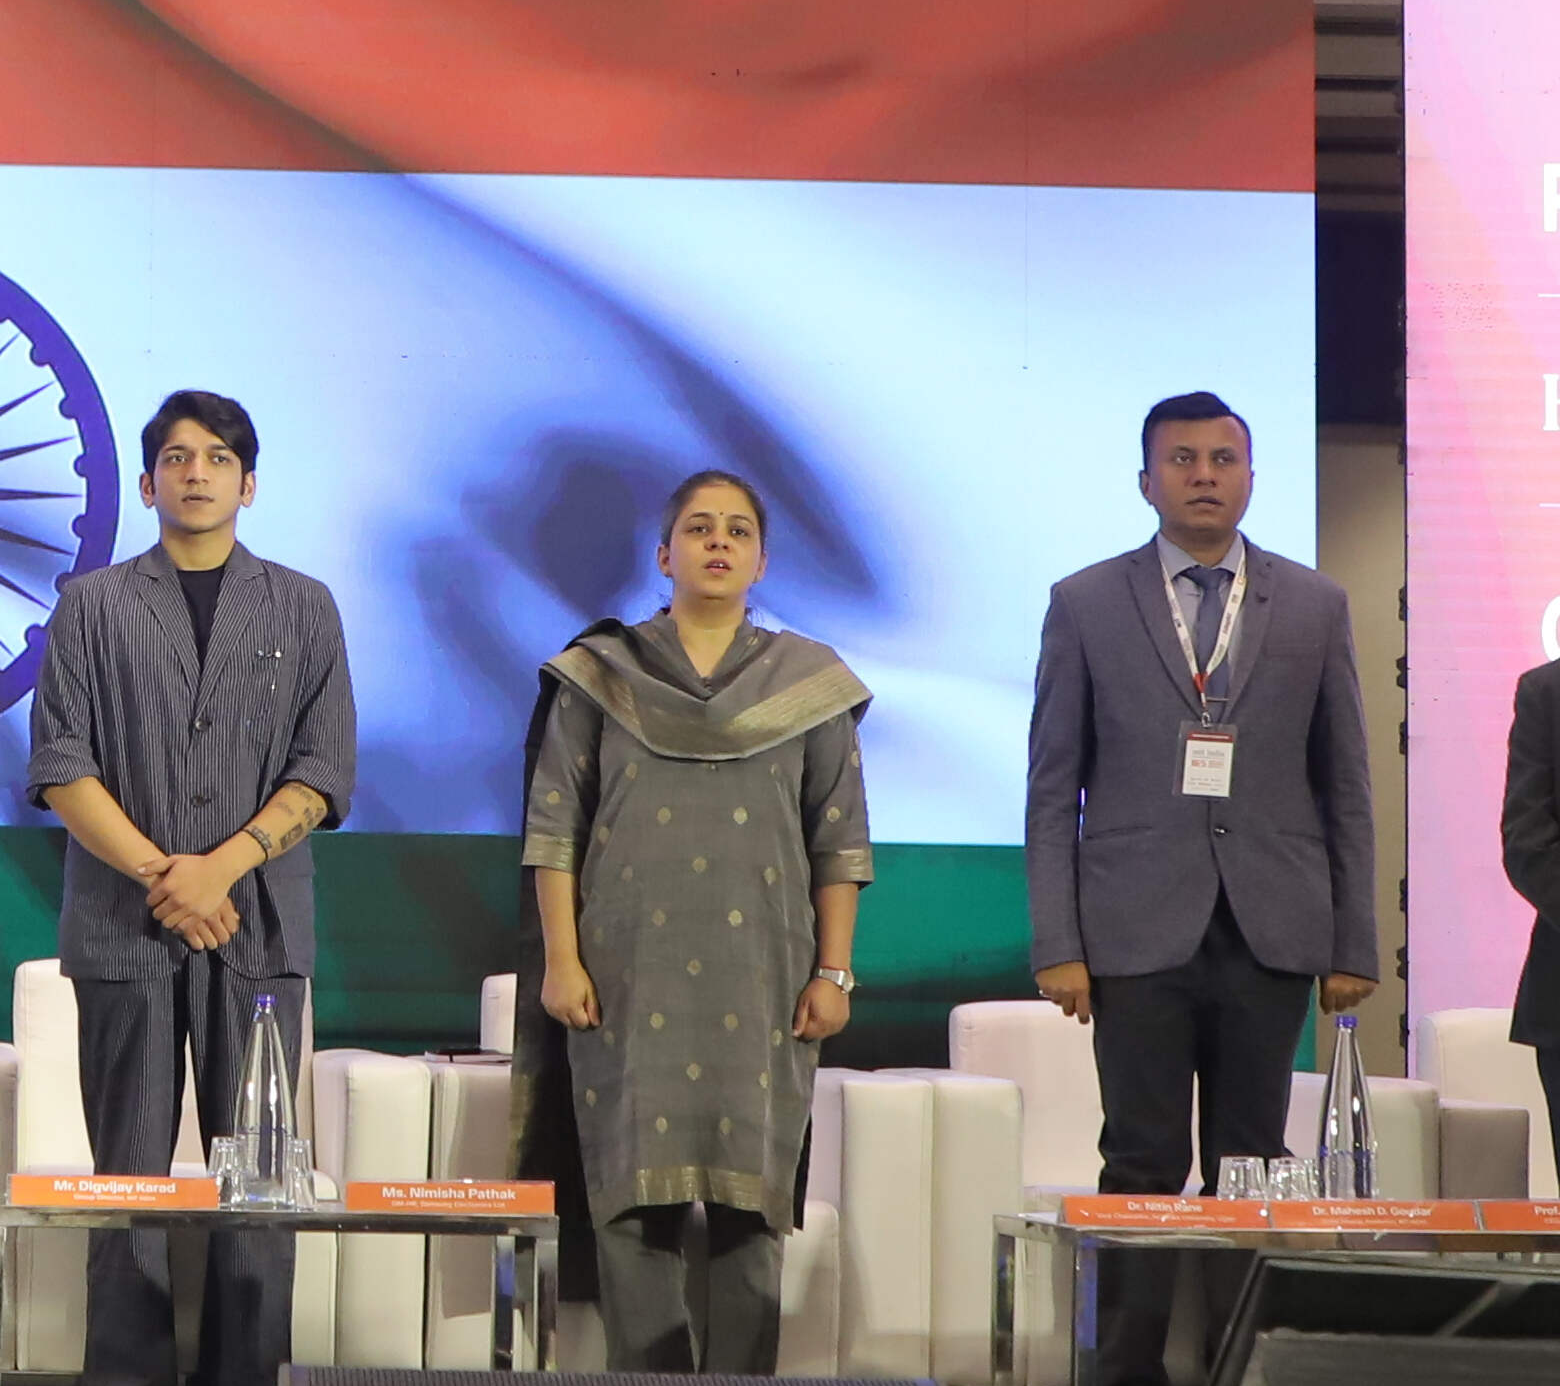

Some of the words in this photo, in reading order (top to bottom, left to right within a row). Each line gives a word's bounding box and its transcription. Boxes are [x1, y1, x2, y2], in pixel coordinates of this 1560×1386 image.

[53, 1180, 76, 1192] Mr.
[79, 1180, 133, 1195] Digvijay
[136, 1182, 176, 1194] Karad
[382, 1186, 407, 1199] Ms.
[409, 1187, 465, 1200] Nimisha
[467, 1188, 516, 1201] Pathak
